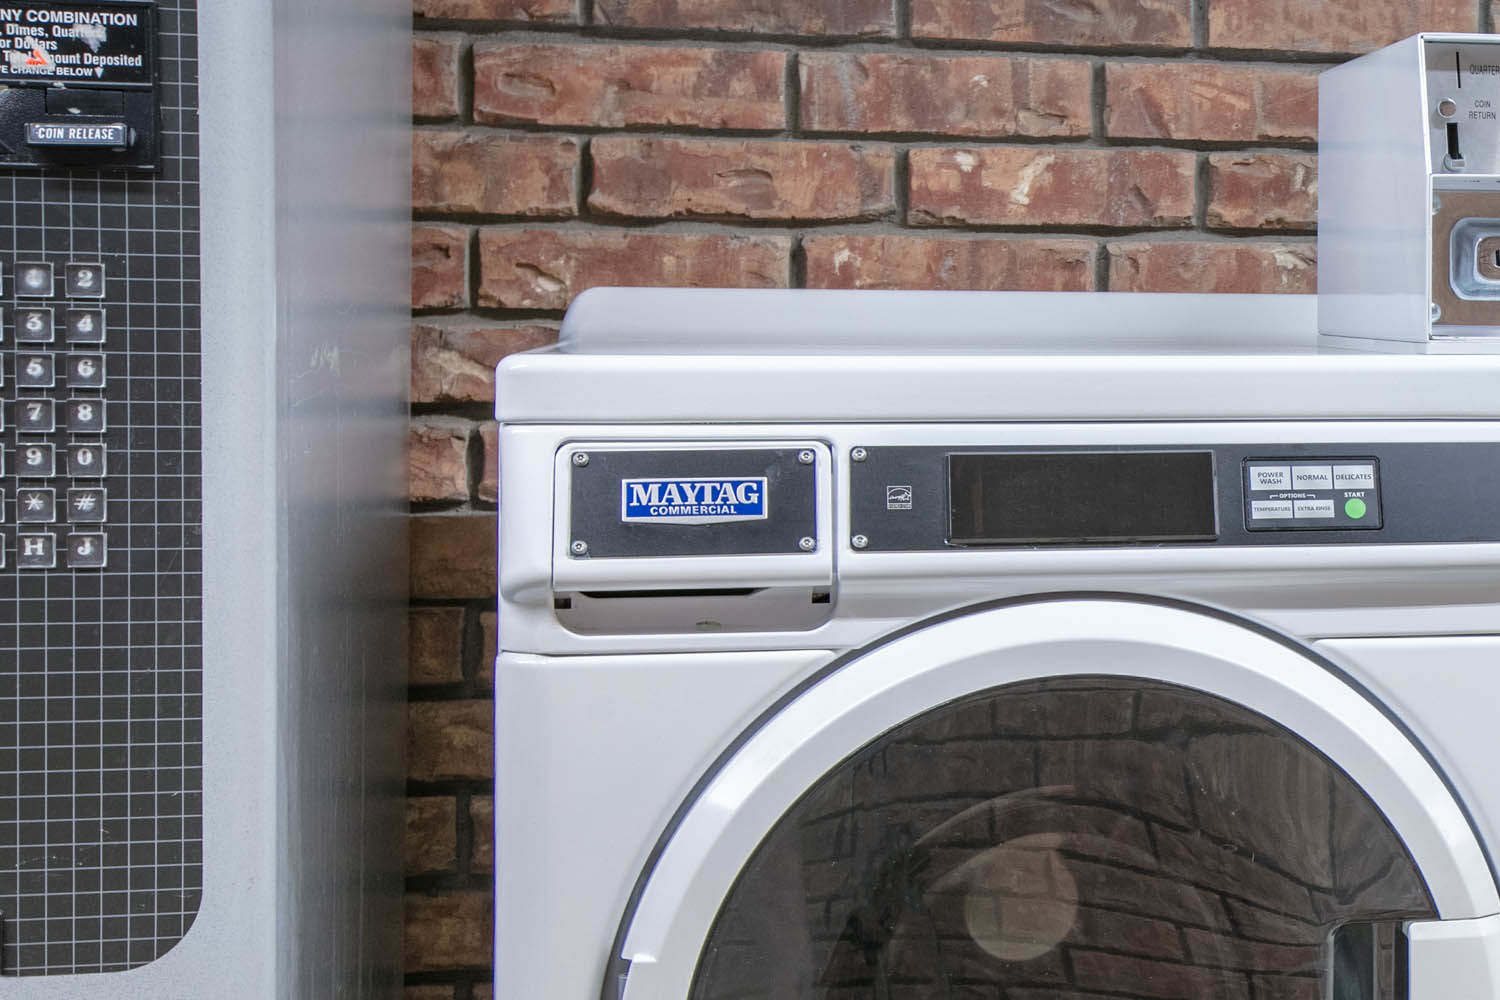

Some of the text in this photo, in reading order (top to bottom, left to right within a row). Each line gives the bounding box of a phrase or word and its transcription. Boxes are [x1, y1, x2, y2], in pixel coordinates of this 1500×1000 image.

[26, 10, 138, 26] COMBINATION
[7, 24, 49, 37] Dimes,
[45, 53, 80, 65] ount
[84, 53, 142, 67] Deposited
[56, 67, 93, 76] BELOW
[1474, 99, 1491, 108] COIN
[1468, 111, 1497, 120] RETURN
[38, 128, 115, 140] COIN RELEASE
[78, 270, 93, 287] 2
[26, 313, 93, 331] 3 4
[27, 358, 94, 376] 5 6
[27, 403, 92, 420] 7 8
[26, 448, 92, 465] 9 0
[629, 482, 760, 506] MAYTAG
[74, 494, 96, 511] #
[650, 505, 737, 515] COMMERCIAL
[23, 538, 92, 555] H J
